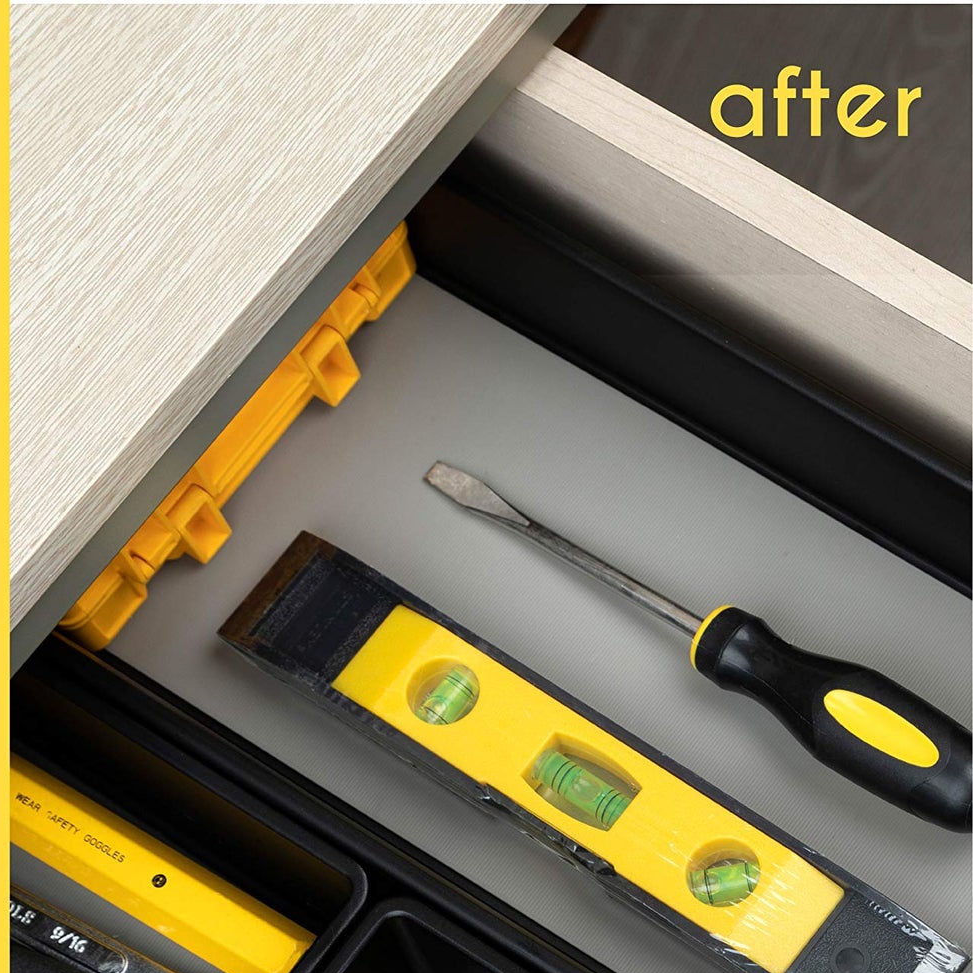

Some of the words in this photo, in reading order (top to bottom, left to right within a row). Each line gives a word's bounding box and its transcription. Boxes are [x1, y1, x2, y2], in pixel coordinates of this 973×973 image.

[15, 792, 41, 812] WEAR
[83, 834, 126, 863] GOGGLES
[50, 926, 88, 953] 9/16
